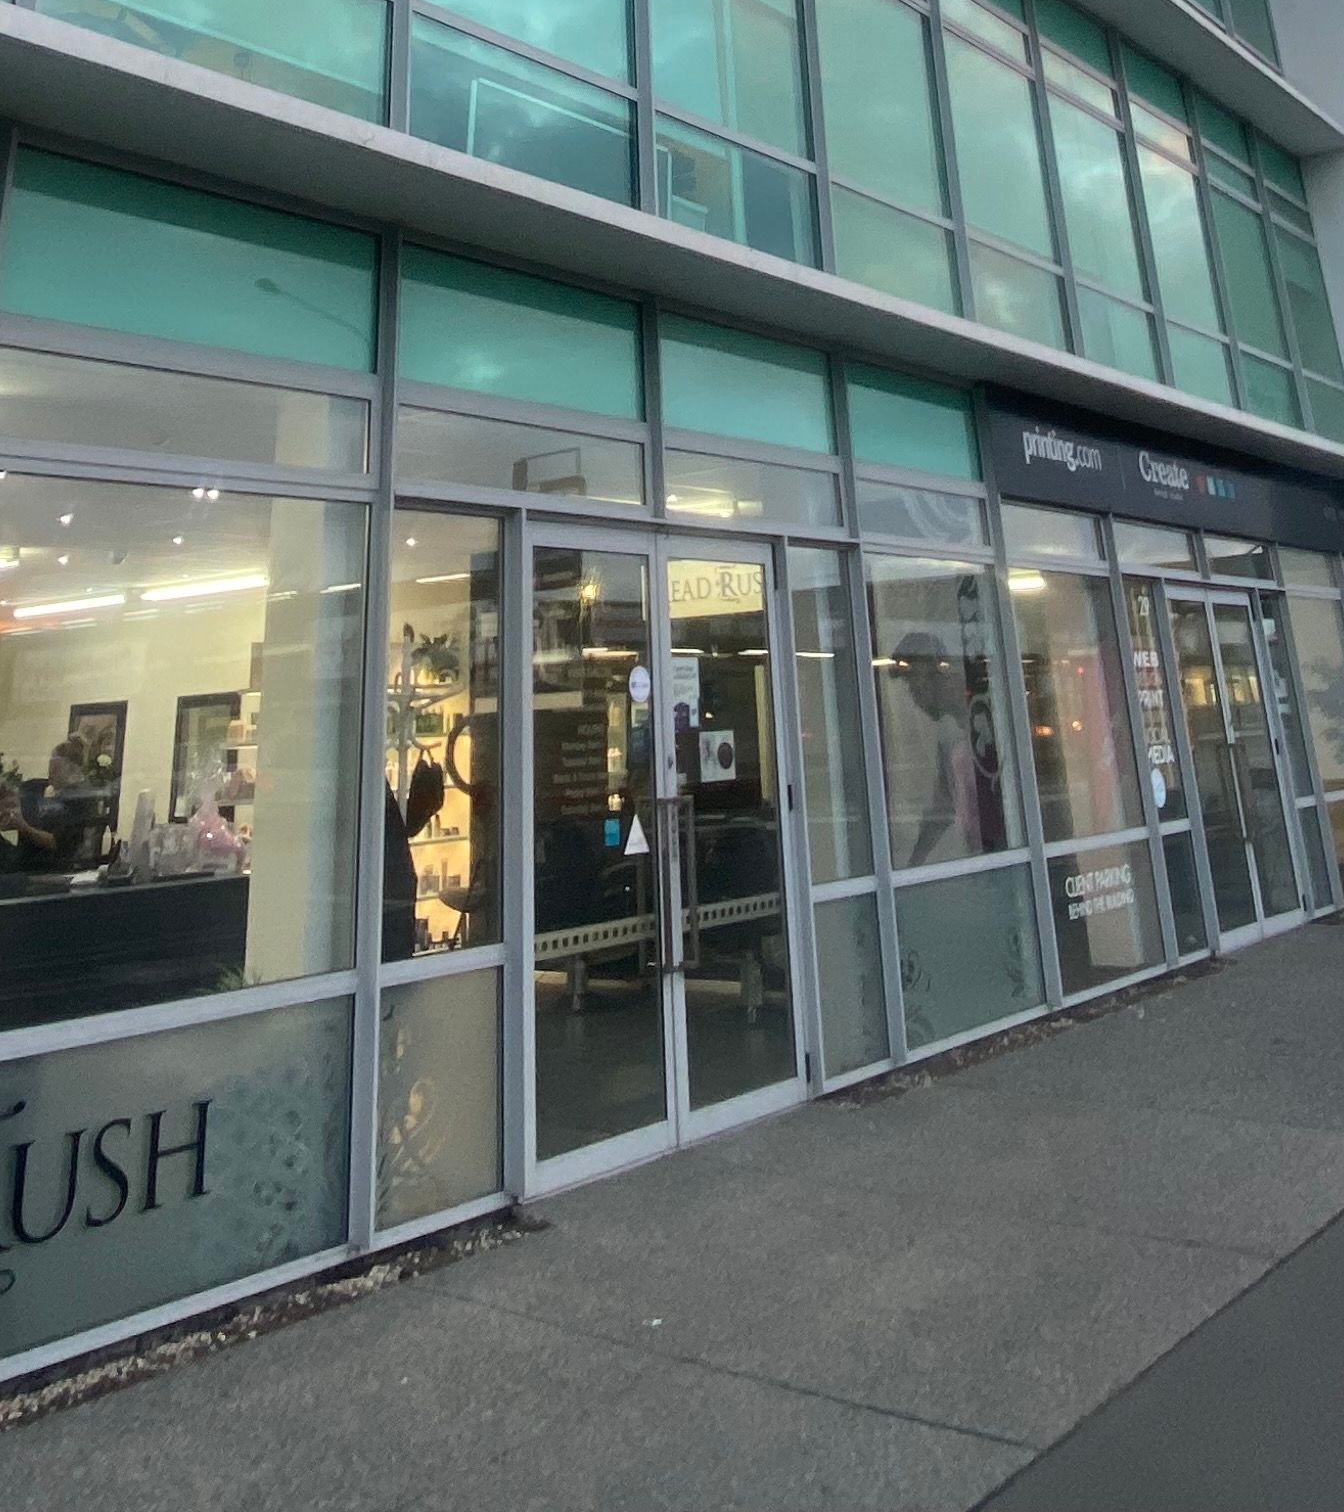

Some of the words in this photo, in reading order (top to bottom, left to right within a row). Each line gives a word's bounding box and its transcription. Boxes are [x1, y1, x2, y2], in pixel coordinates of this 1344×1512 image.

[1021, 425, 1103, 472] printing.com
[1138, 450, 1190, 490] Create
[670, 576, 712, 603] EAD
